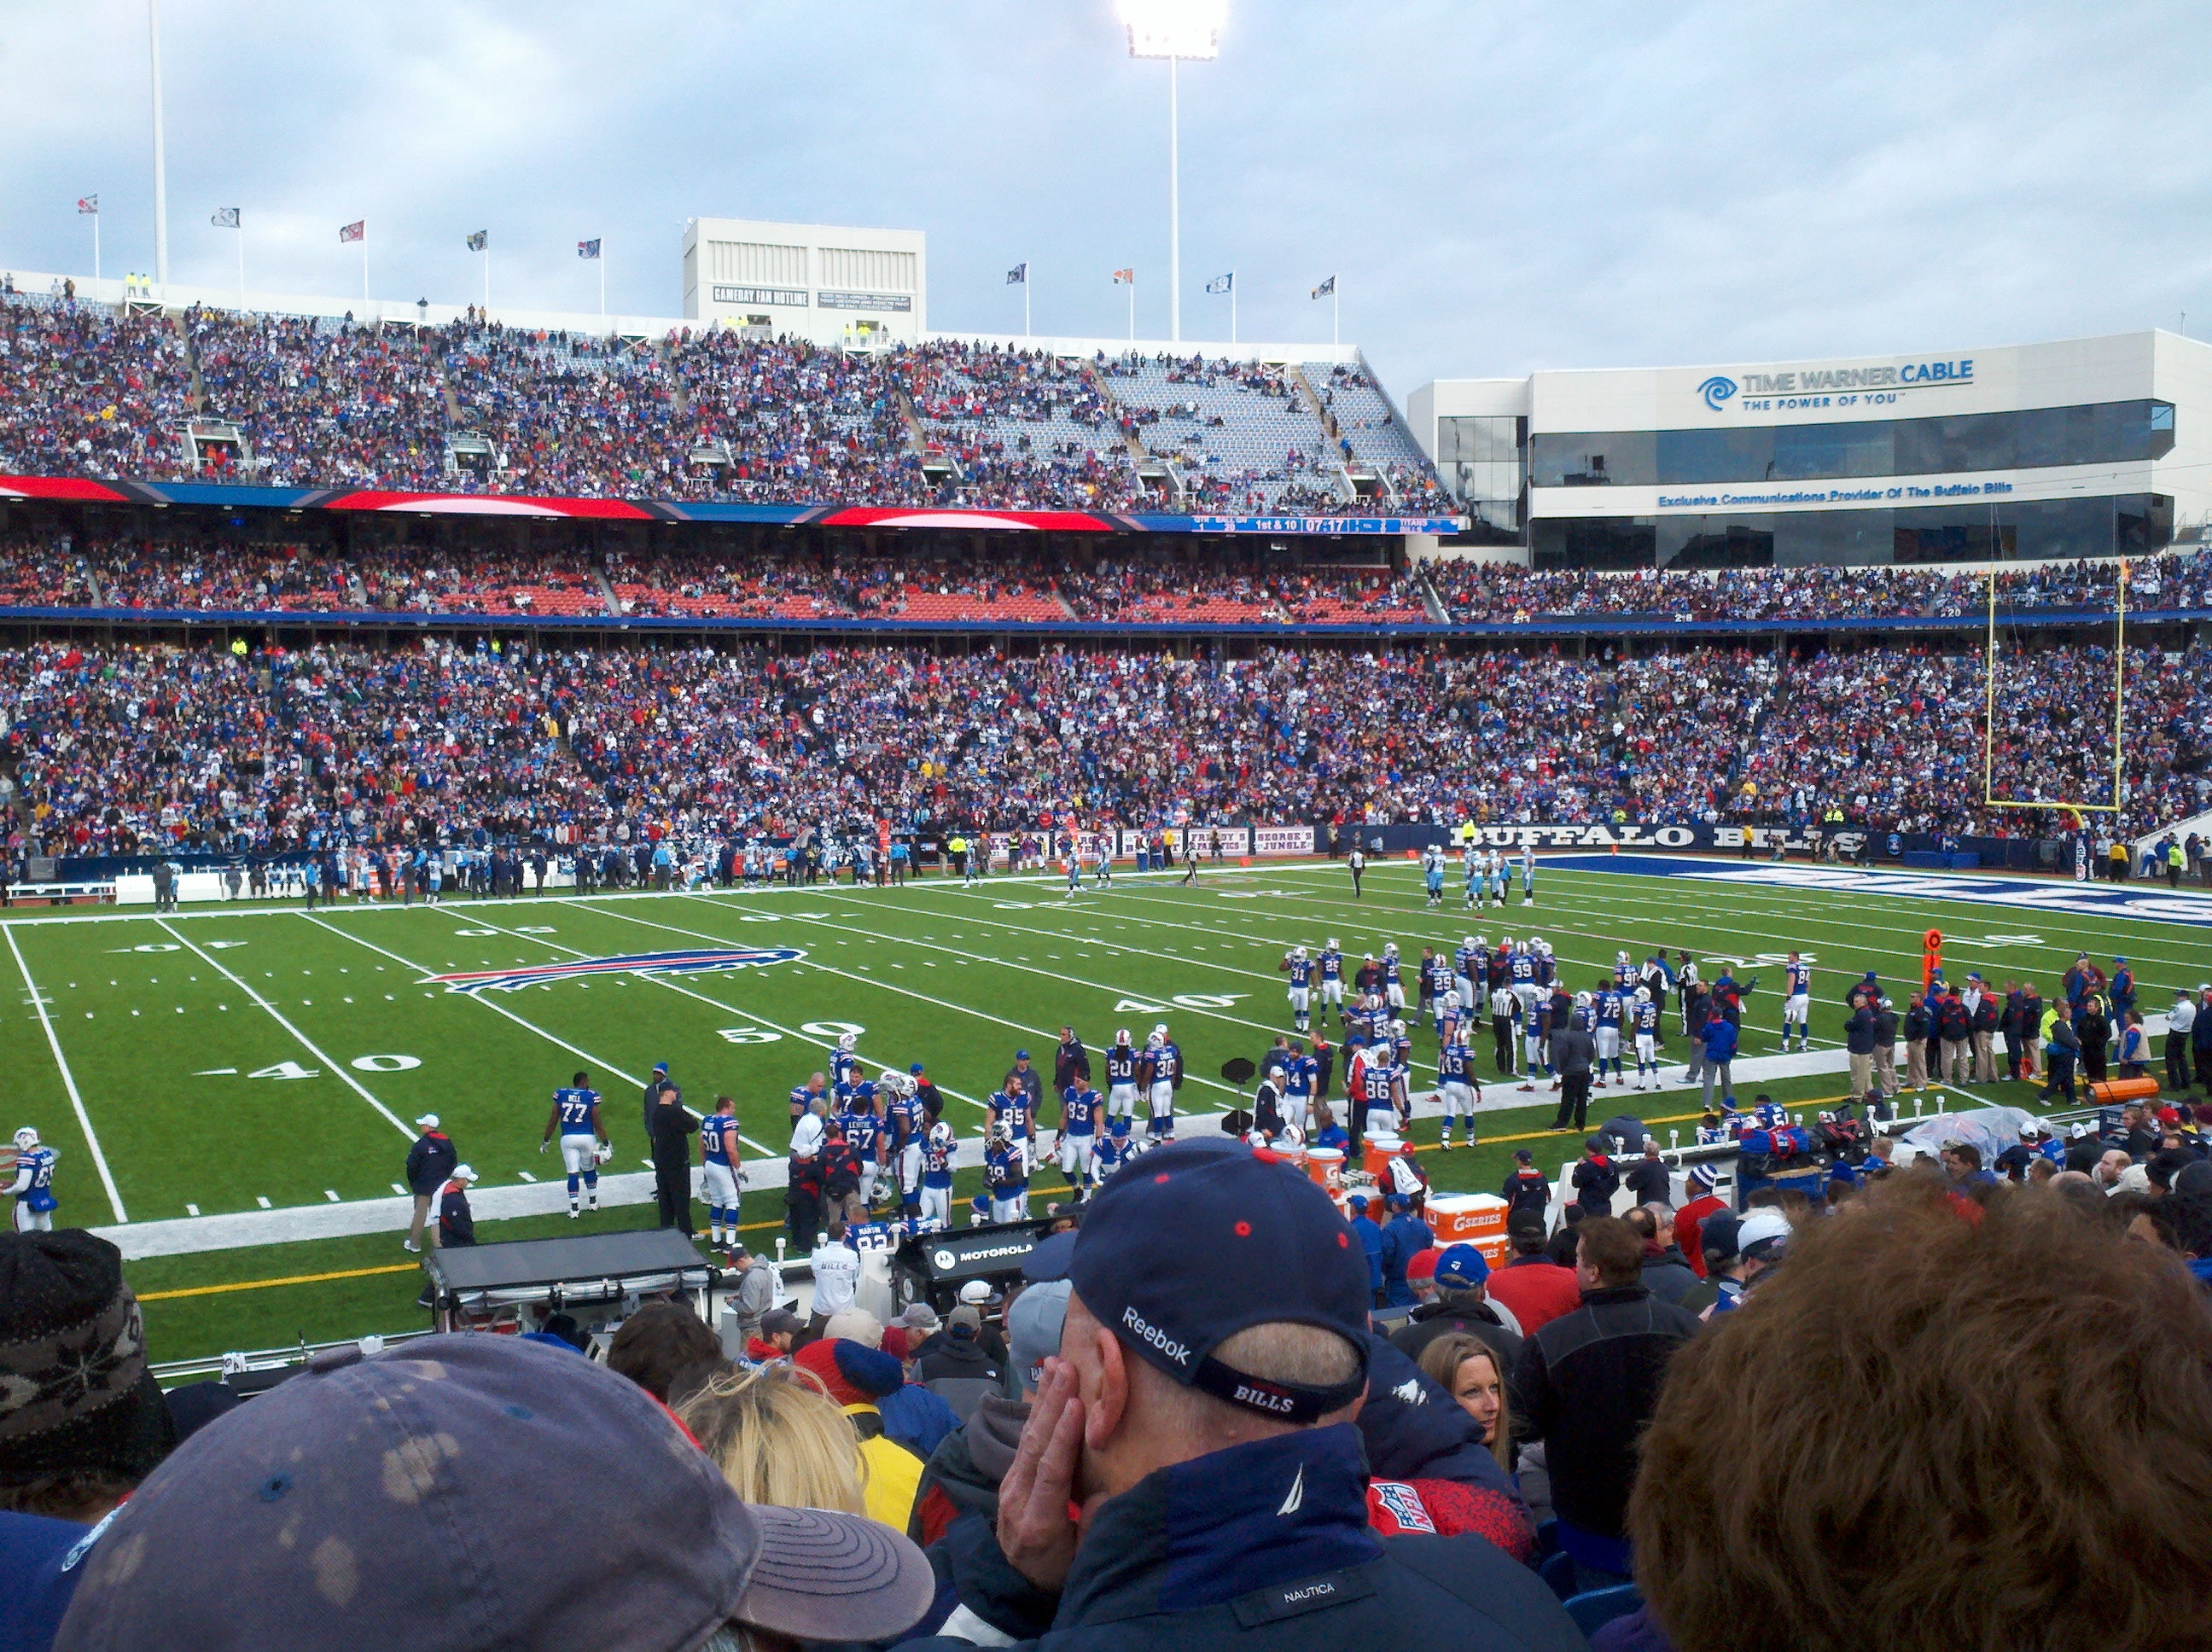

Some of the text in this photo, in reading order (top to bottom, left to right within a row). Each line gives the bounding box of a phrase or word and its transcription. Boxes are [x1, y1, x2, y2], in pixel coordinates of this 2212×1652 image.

[714, 288, 754, 303] GAMEDAY
[756, 289, 772, 304] FAN
[773, 291, 807, 306] HOTLINE
[1742, 359, 1975, 393] TIME WARNER CABLE
[1743, 400, 1772, 411] THE
[1778, 397, 1831, 410] POWER
[1838, 395, 1859, 407] OF
[1659, 481, 2013, 507] Exclusive Communications Provider Of The Buffalo Bills
[1256, 520, 1272, 530] 1st
[1284, 520, 1297, 530] 10
[1257, 831, 1312, 841] GEORGE'S
[1449, 825, 1695, 846] BUFFALO
[1263, 841, 1307, 850] JUNGLE
[1512, 963, 1533, 979] 99
[1109, 1059, 1132, 1077] 20
[1365, 1081, 1390, 1100] 86
[562, 1102, 588, 1123] 77
[846, 1128, 875, 1149] 67
[959, 1243, 1033, 1262] MOTOROLA
[1121, 1306, 1191, 1366] Reebok
[1234, 1385, 1295, 1413] BILLS
[1284, 1583, 1336, 1603] NAUTICA
